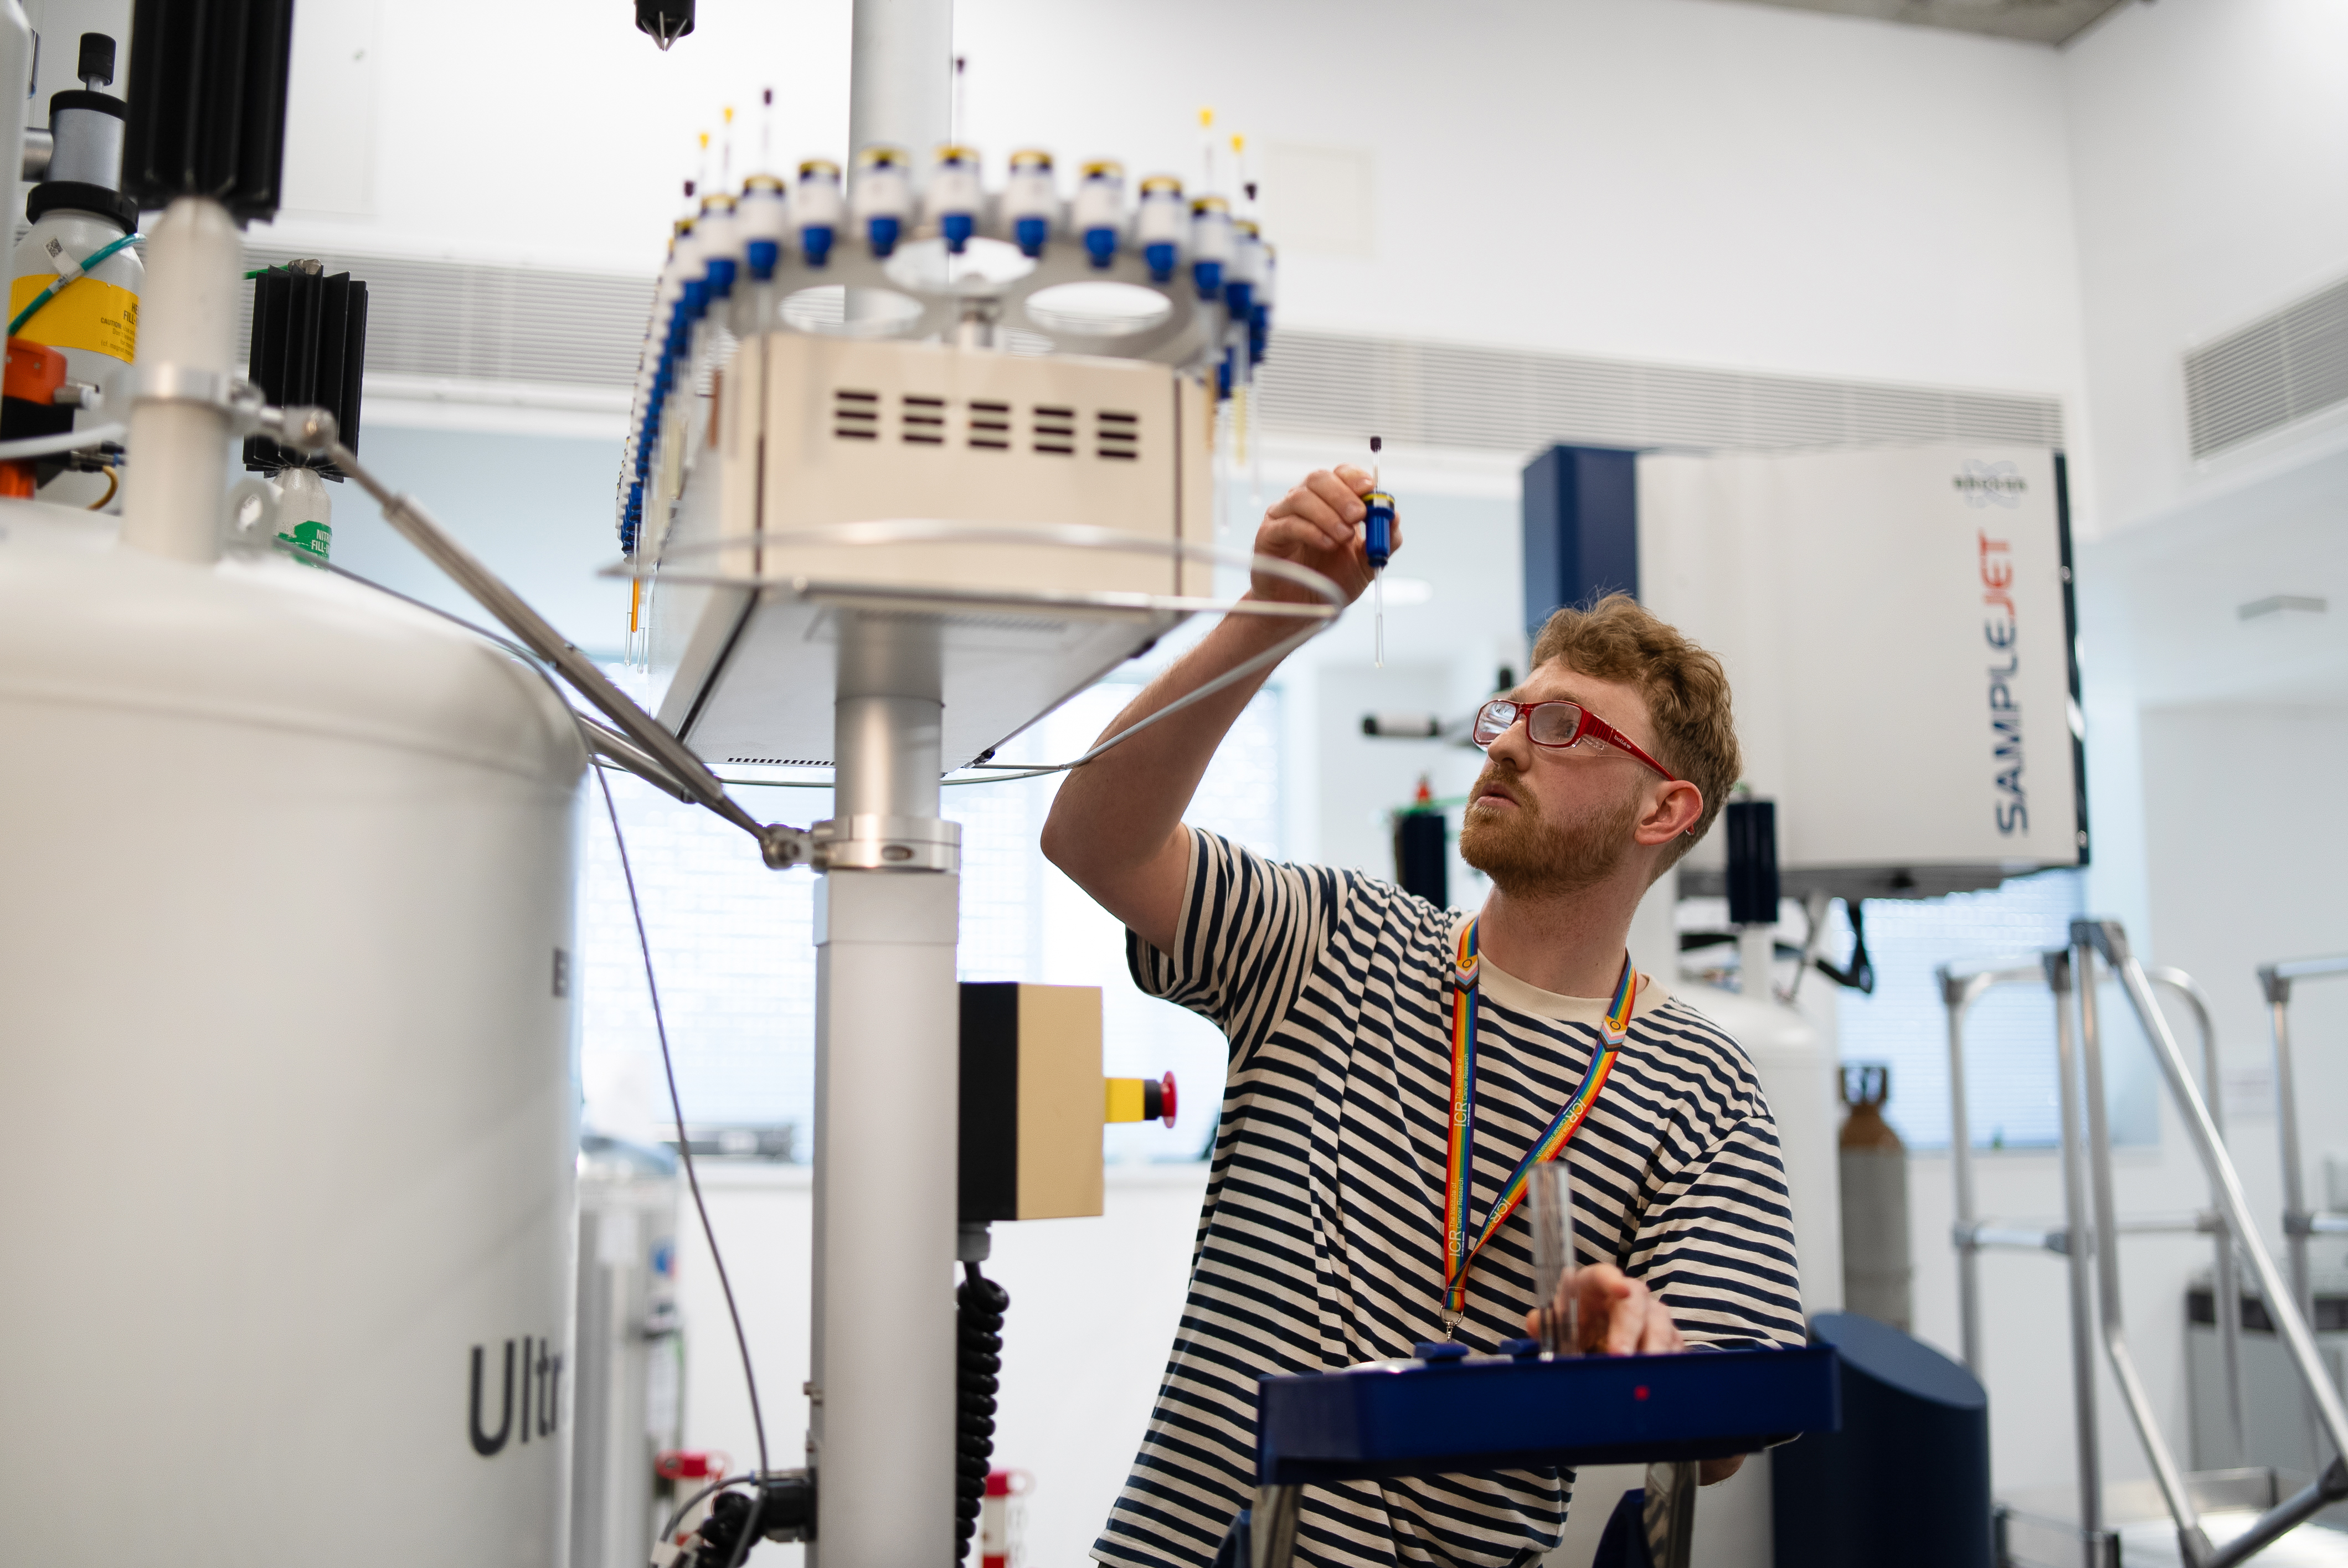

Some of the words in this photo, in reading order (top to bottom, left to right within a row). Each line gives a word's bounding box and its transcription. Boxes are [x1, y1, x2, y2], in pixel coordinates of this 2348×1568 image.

[1978, 527, 2030, 837] SAMPLEJET
[1454, 1102, 1468, 1127] ICR
[1565, 1098, 1587, 1123] ICR
[1553, 1118, 1567, 1136] Cancer
[1536, 1134, 1555, 1158] Research
[1490, 1198, 1512, 1223] ICR
[1449, 1230, 1462, 1257] ICR
